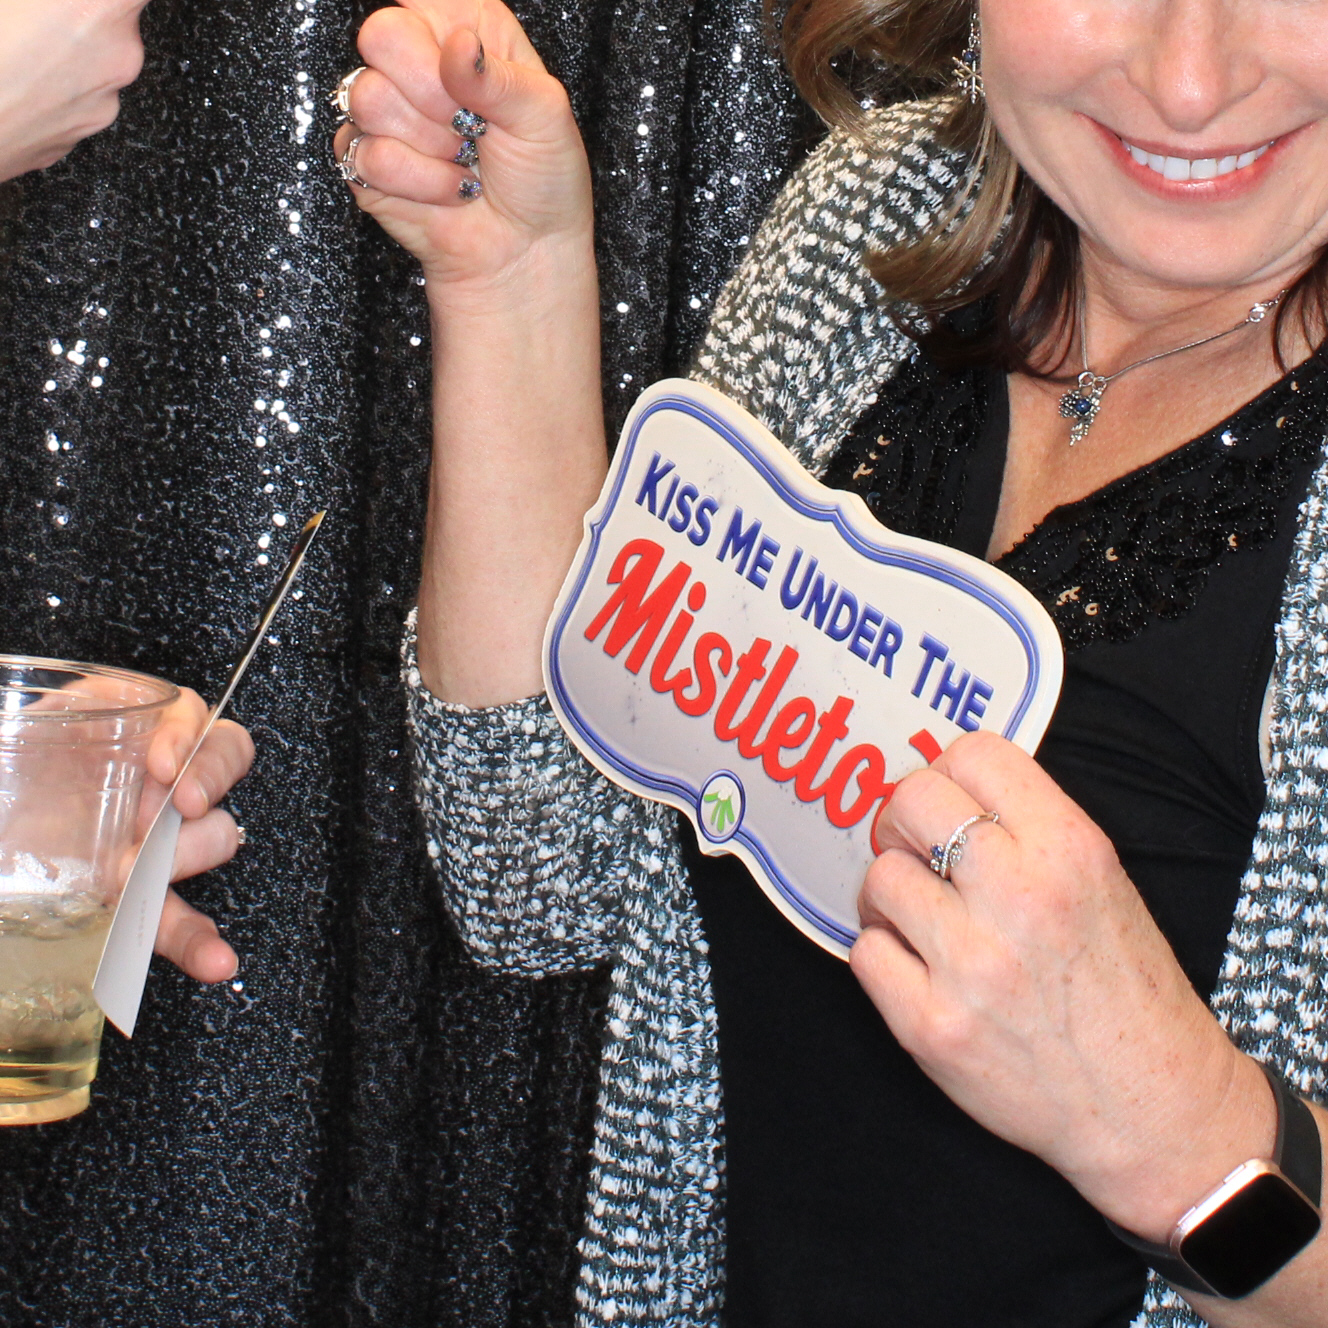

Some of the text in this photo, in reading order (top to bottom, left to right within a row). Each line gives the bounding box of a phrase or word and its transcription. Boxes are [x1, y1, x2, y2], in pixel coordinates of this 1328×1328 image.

[584, 538, 943, 857] Mistleto
[635, 451, 719, 546] KISS
[779, 546, 904, 678] UNDER
[910, 632, 994, 732] THE
